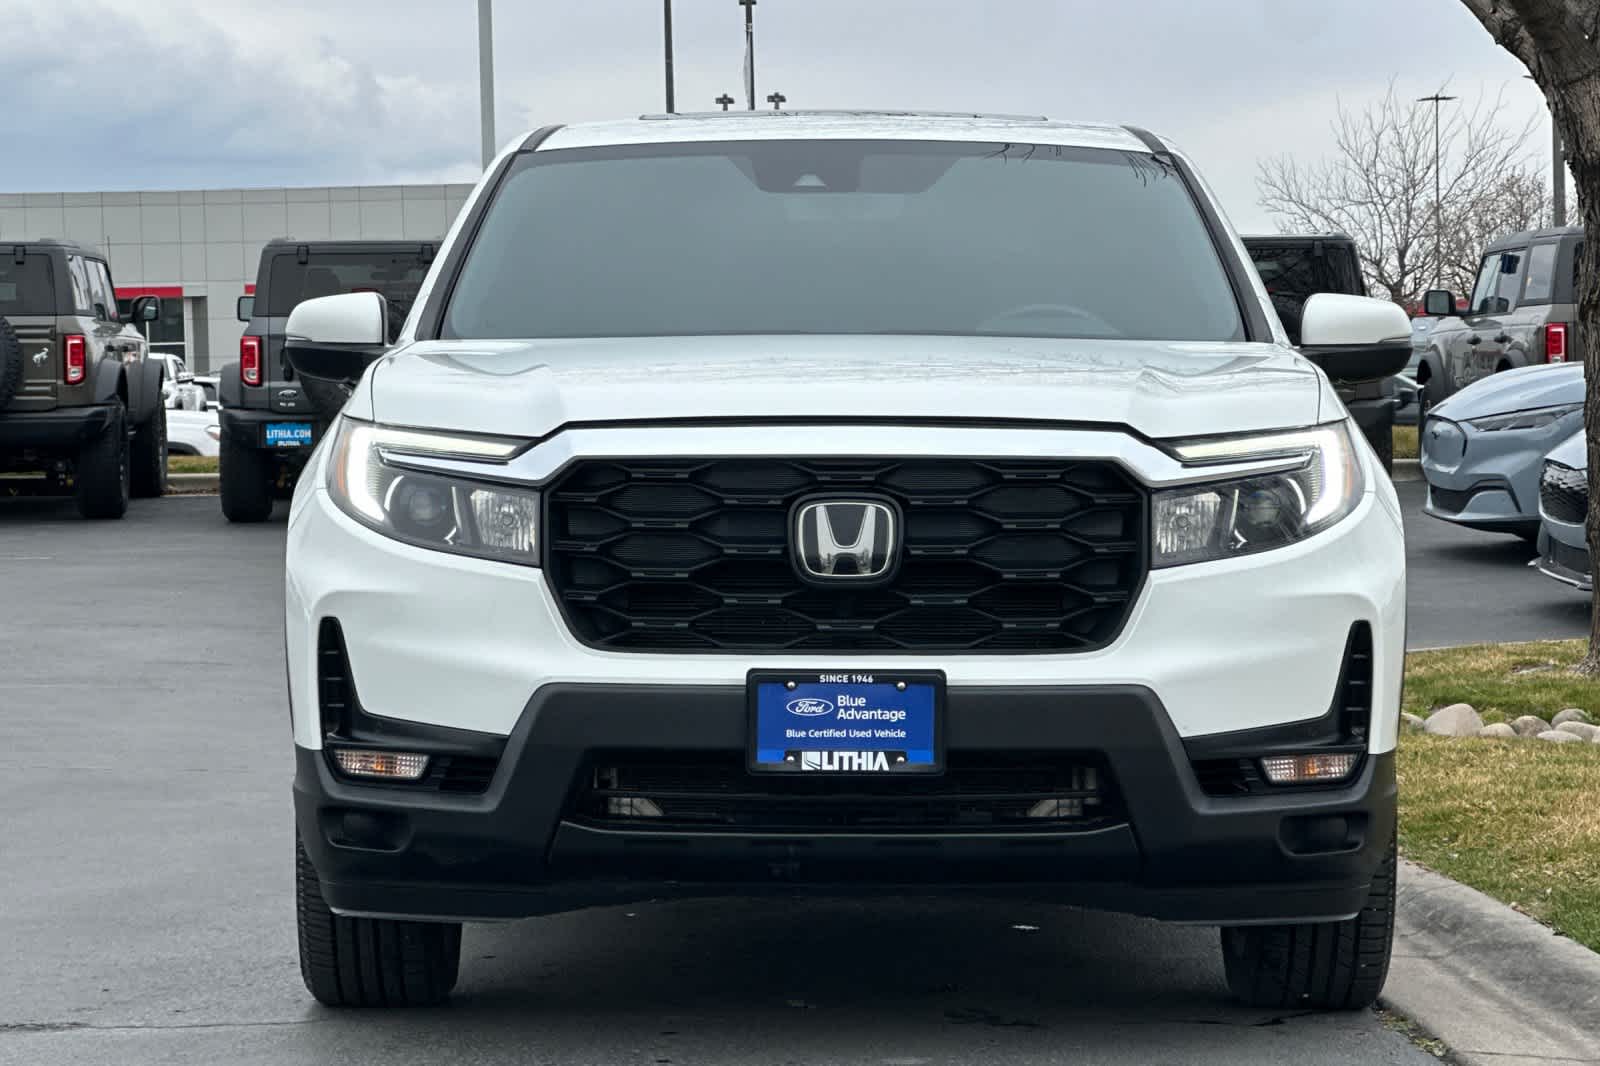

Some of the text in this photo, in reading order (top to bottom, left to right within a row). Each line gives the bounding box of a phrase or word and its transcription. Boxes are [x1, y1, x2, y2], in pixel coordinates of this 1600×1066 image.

[819, 675, 874, 683] SINCE 1946
[837, 695, 866, 706] Blue
[794, 700, 826, 714] Ford
[837, 708, 906, 722] Advantage
[786, 729, 906, 738] Blue Certified Used Vehicle
[822, 751, 889, 771] LITHIA
